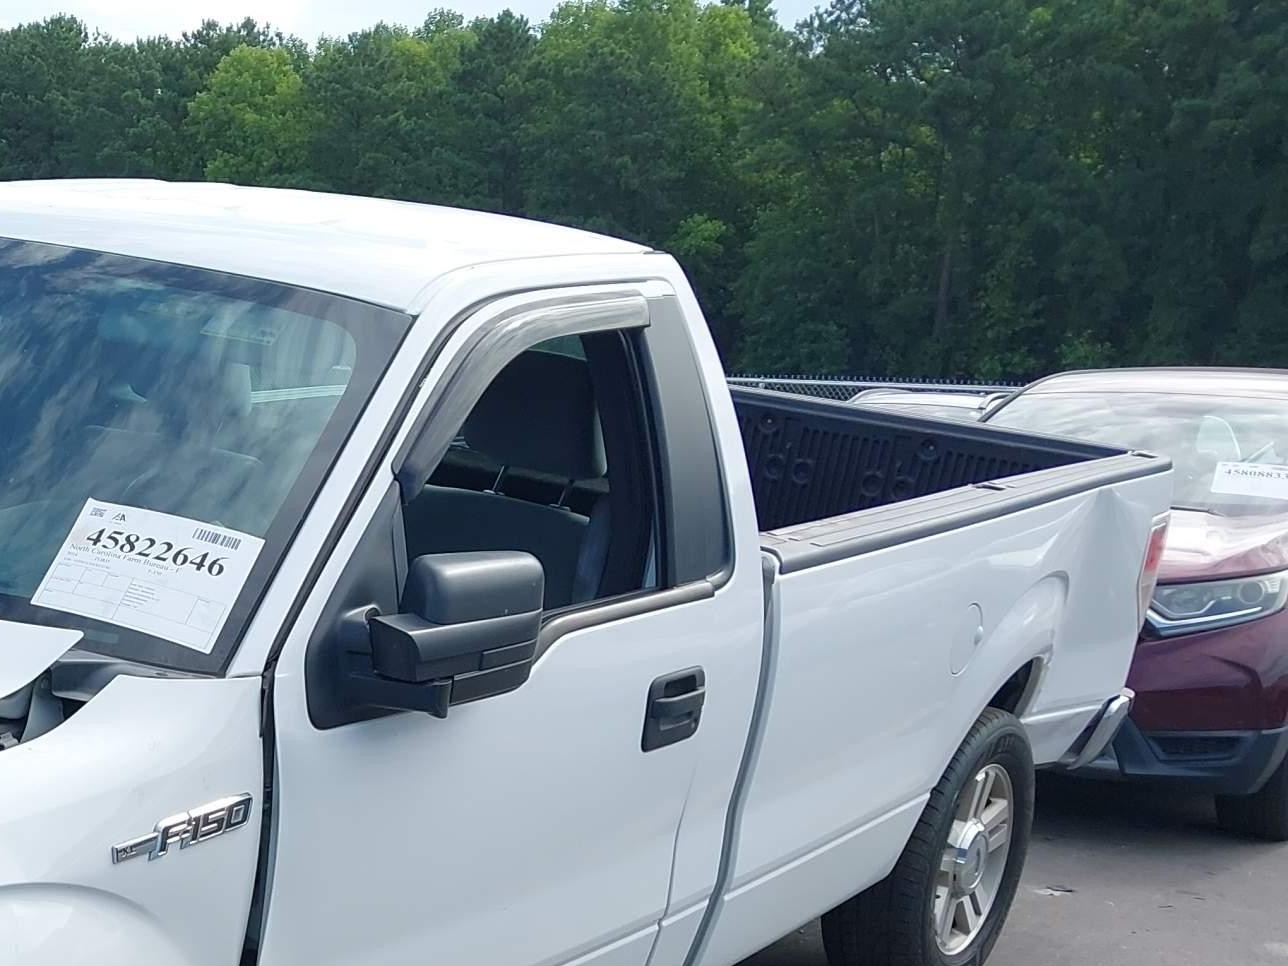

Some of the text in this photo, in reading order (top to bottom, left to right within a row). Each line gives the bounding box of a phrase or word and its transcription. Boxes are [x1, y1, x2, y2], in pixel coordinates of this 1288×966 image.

[69, 543, 90, 553] North
[92, 548, 121, 560] Carolina
[122, 553, 142, 563] Farm
[143, 559, 169, 571] Bureau
[86, 527, 230, 577] 45822646
